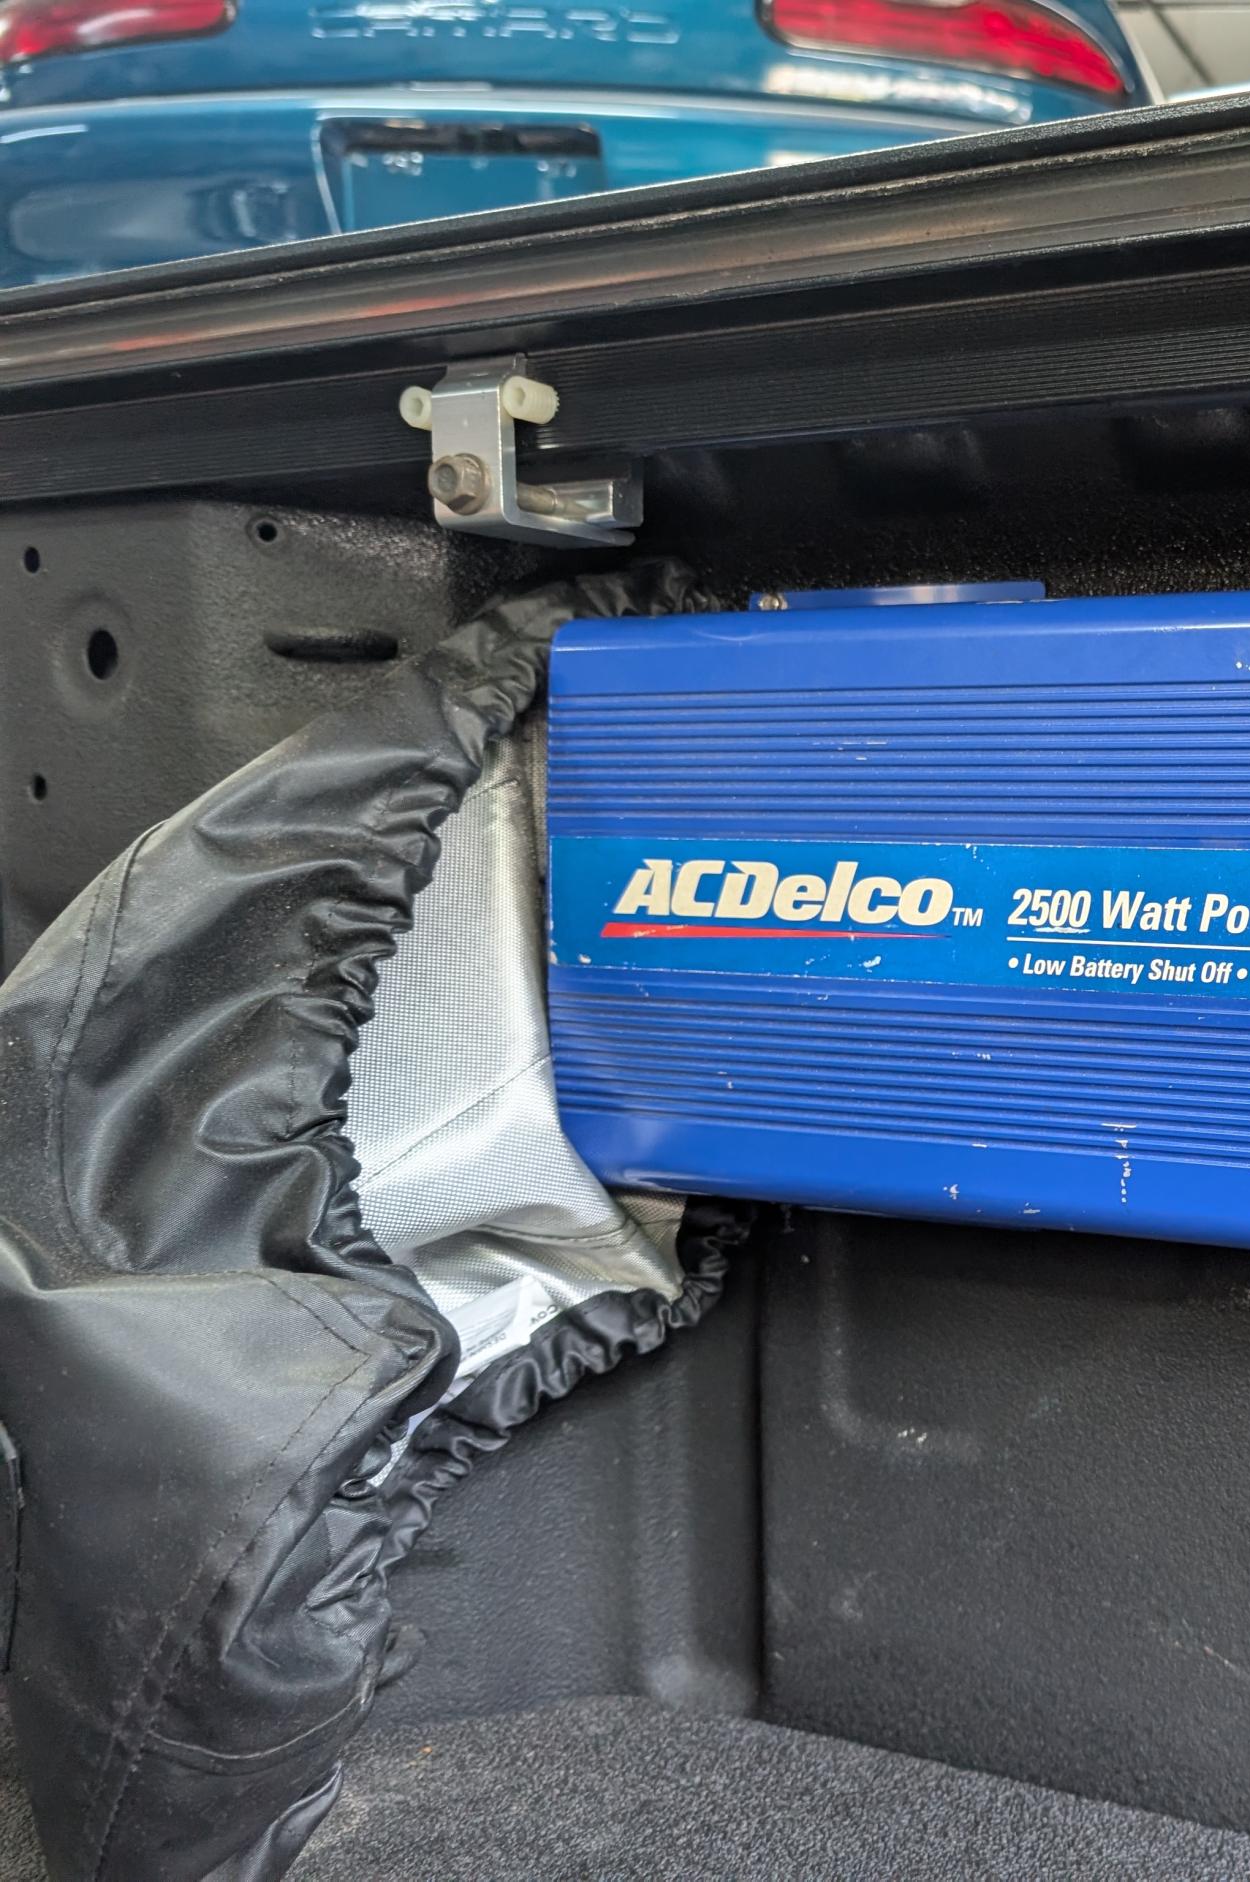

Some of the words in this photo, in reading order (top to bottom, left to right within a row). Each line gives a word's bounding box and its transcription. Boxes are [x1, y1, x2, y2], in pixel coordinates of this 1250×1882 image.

[613, 859, 954, 926] ACDelco
[1007, 888, 1092, 929] 2500
[1102, 890, 1192, 932] Watt
[1022, 953, 1066, 976] Low
[1069, 955, 1145, 985] Battery
[1148, 958, 1197, 982] Shut
[1200, 961, 1234, 984] Off
